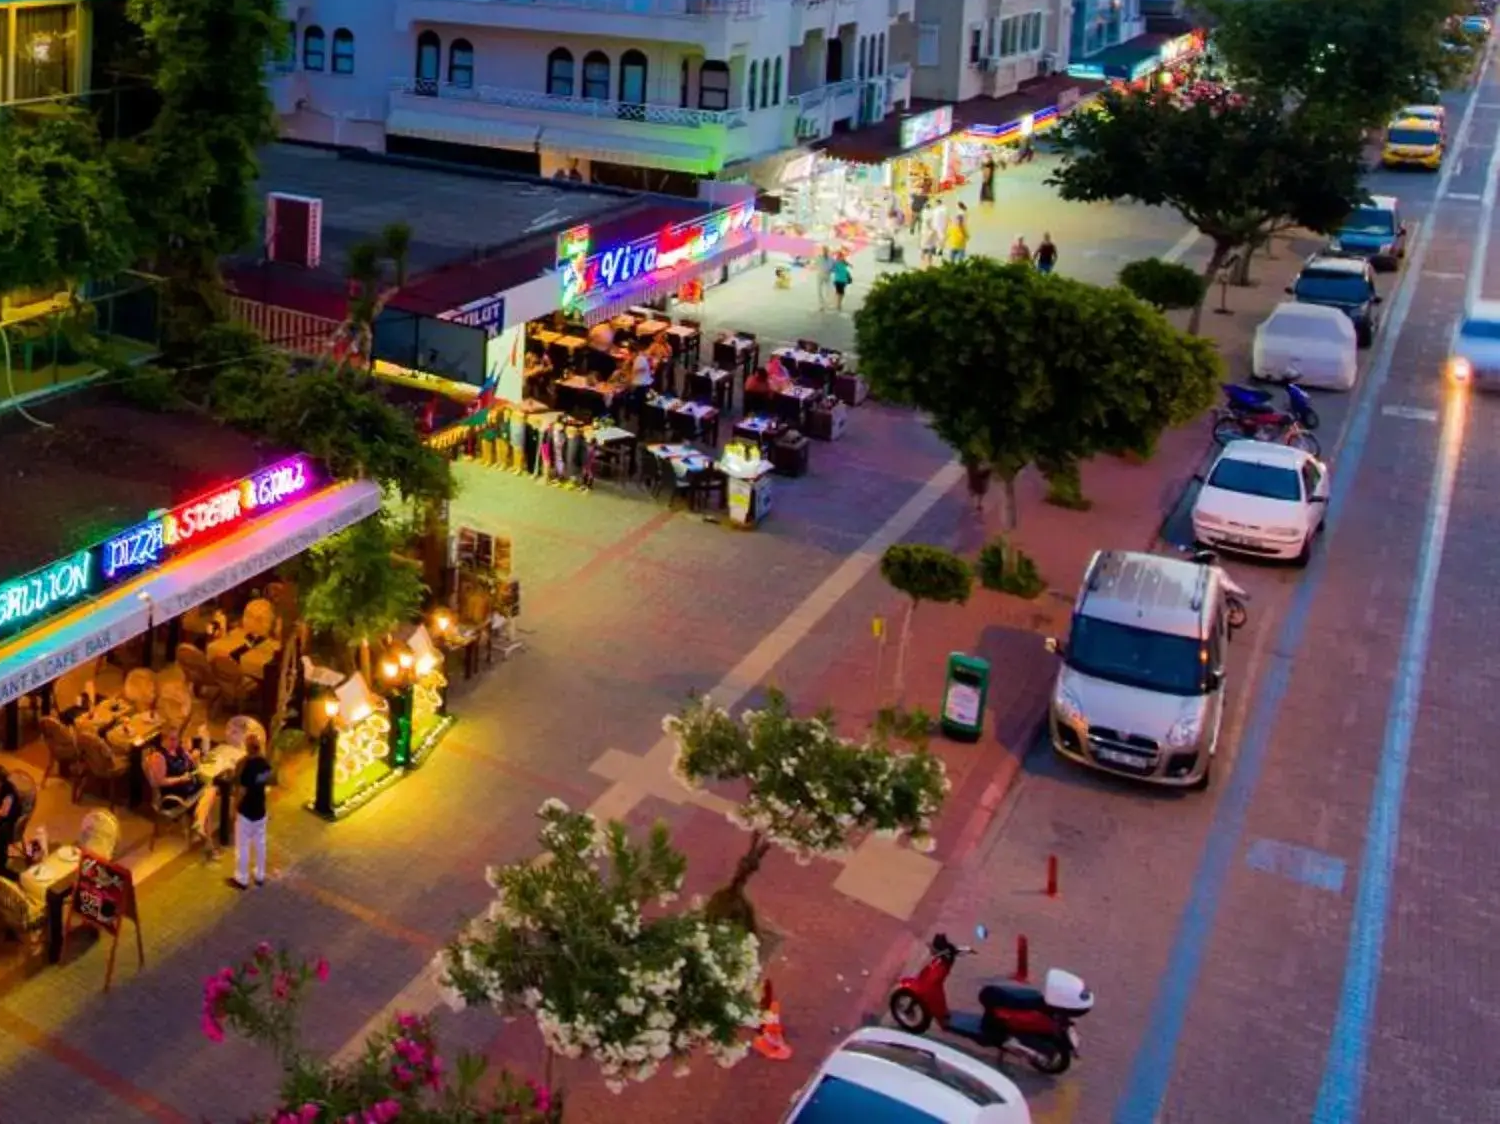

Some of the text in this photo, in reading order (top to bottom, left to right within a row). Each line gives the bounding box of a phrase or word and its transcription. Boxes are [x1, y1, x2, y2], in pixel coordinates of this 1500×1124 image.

[108, 522, 164, 575] PIZZA
[179, 488, 242, 540] STEAK
[258, 462, 307, 505] GRILL
[84, 632, 113, 656] BAR
